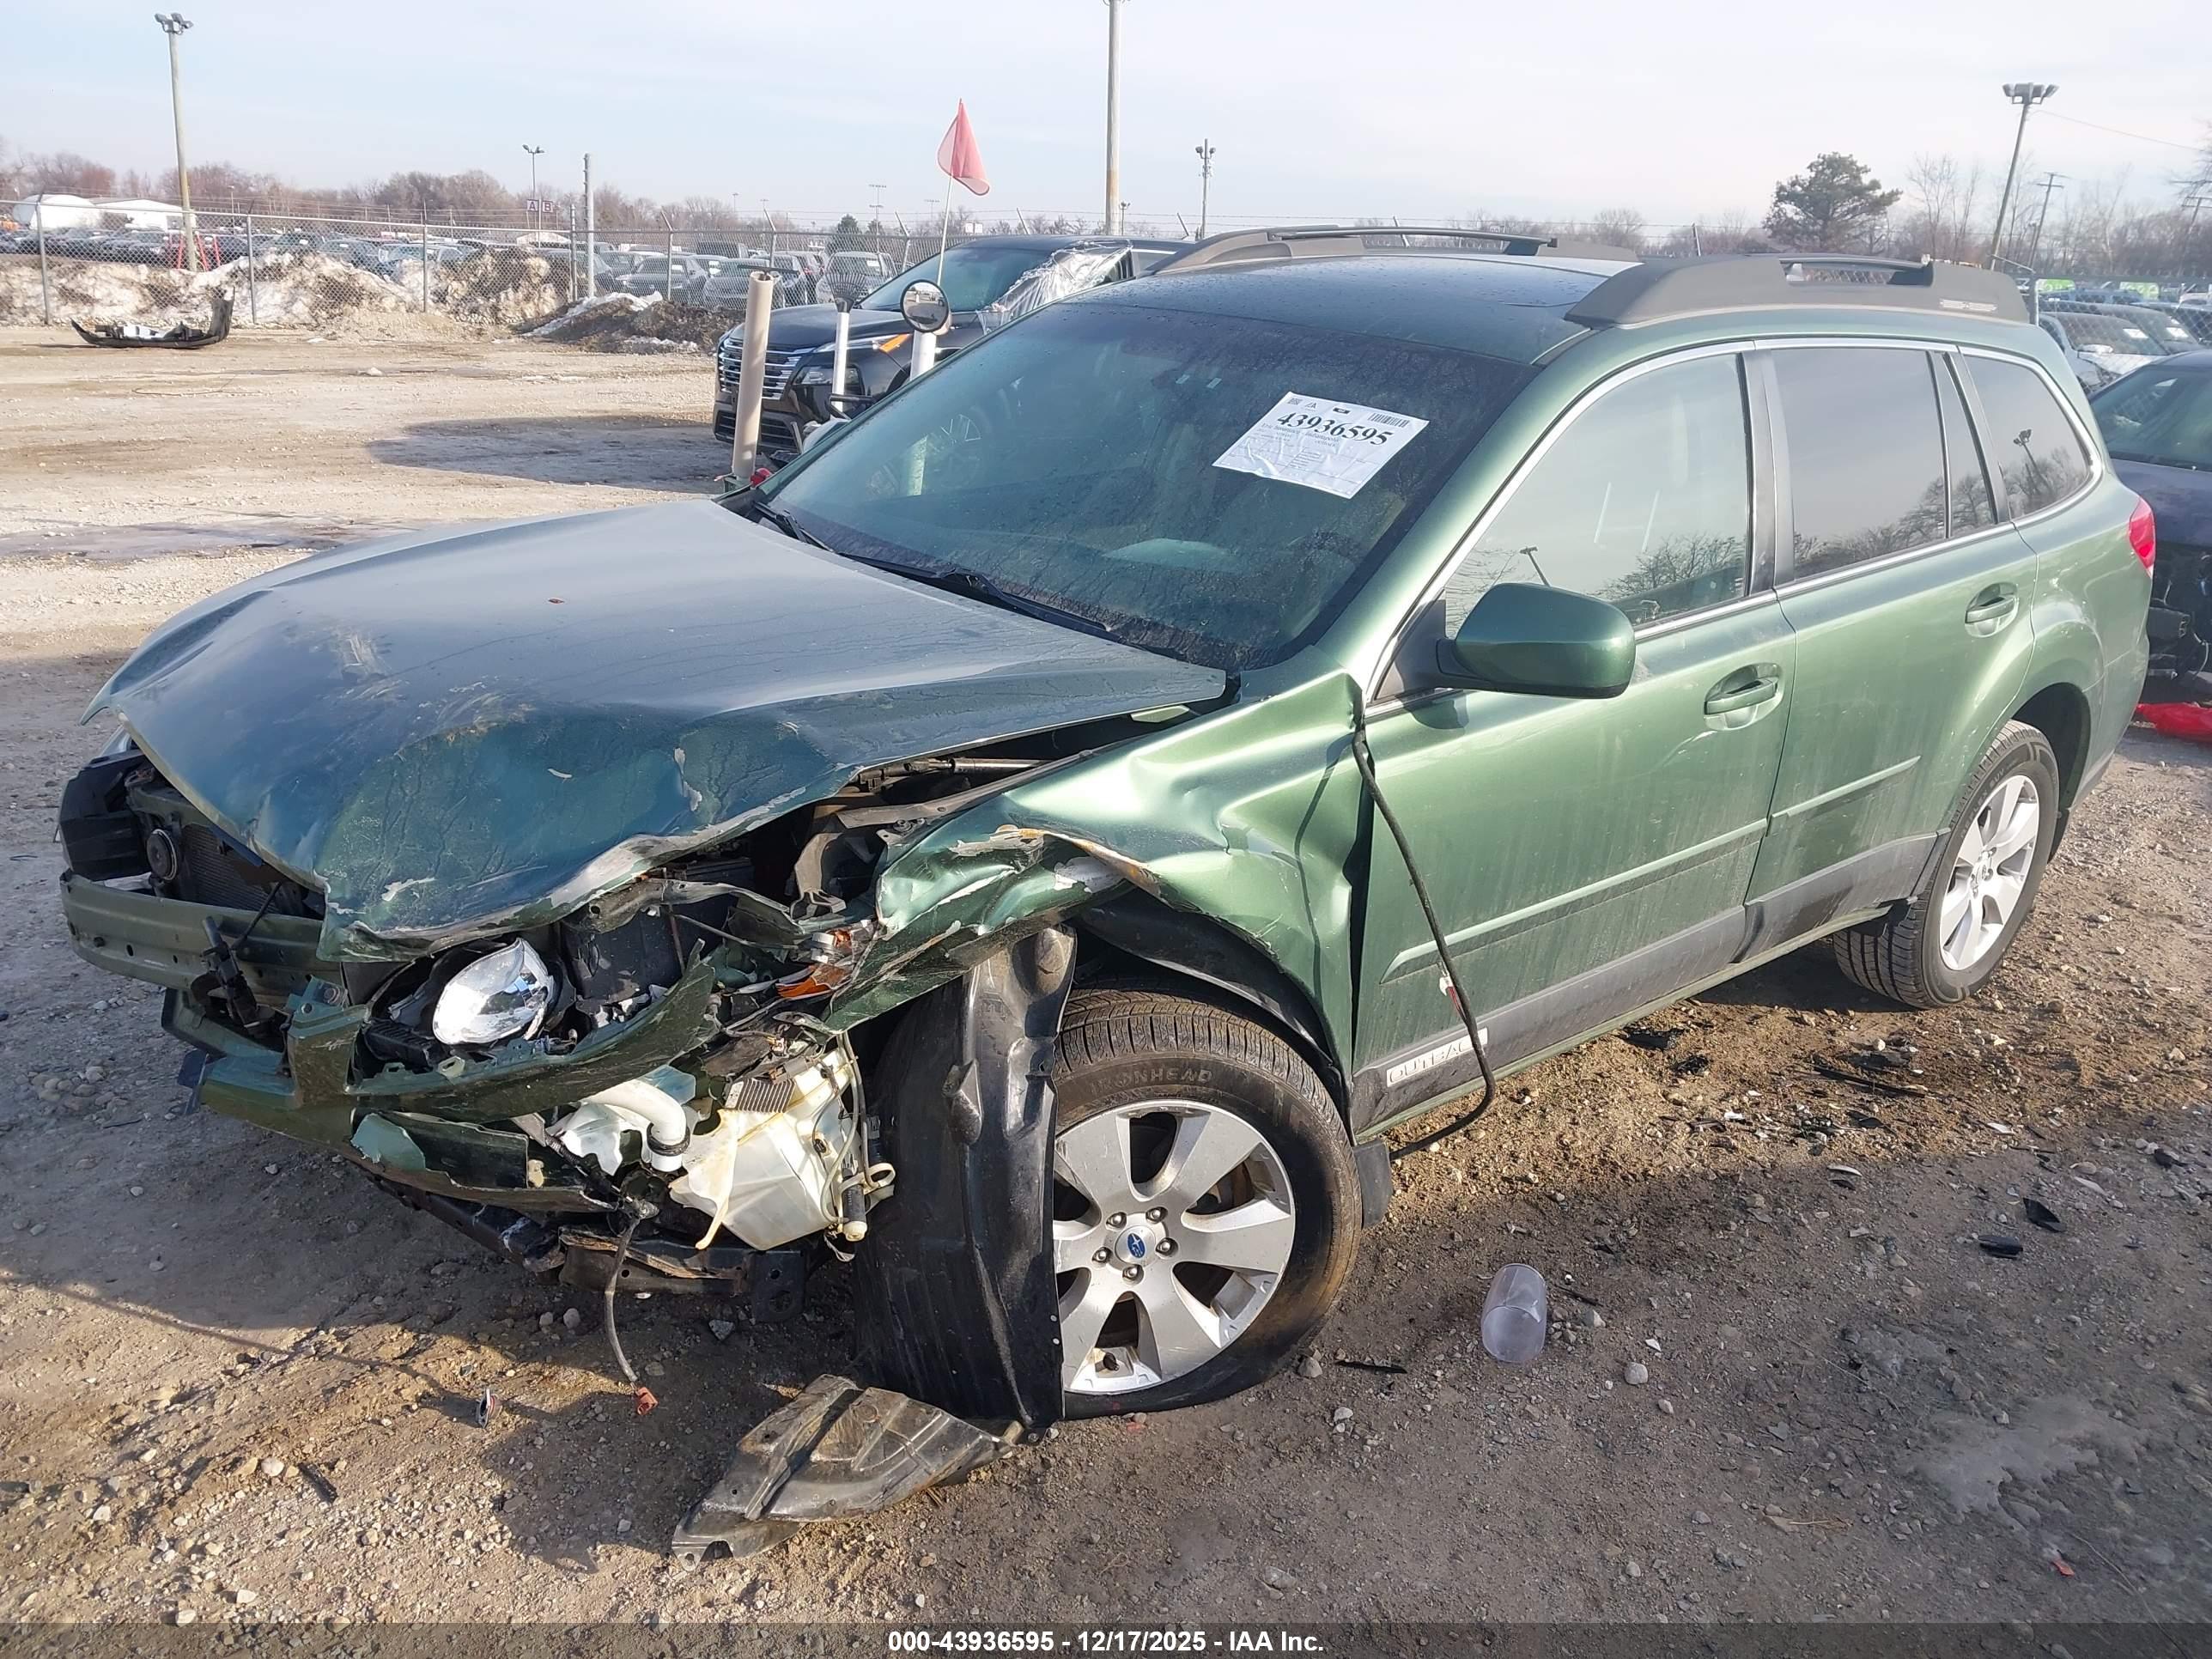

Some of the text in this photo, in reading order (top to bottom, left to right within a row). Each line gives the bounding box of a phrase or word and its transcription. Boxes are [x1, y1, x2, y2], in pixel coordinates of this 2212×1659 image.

[529, 201, 537, 211] A
[544, 202, 551, 211] B
[1277, 412, 1394, 446] 43936595
[1389, 1035, 1475, 1084] OUTBAC
[1091, 1067, 1213, 1096] IRONHEAD
